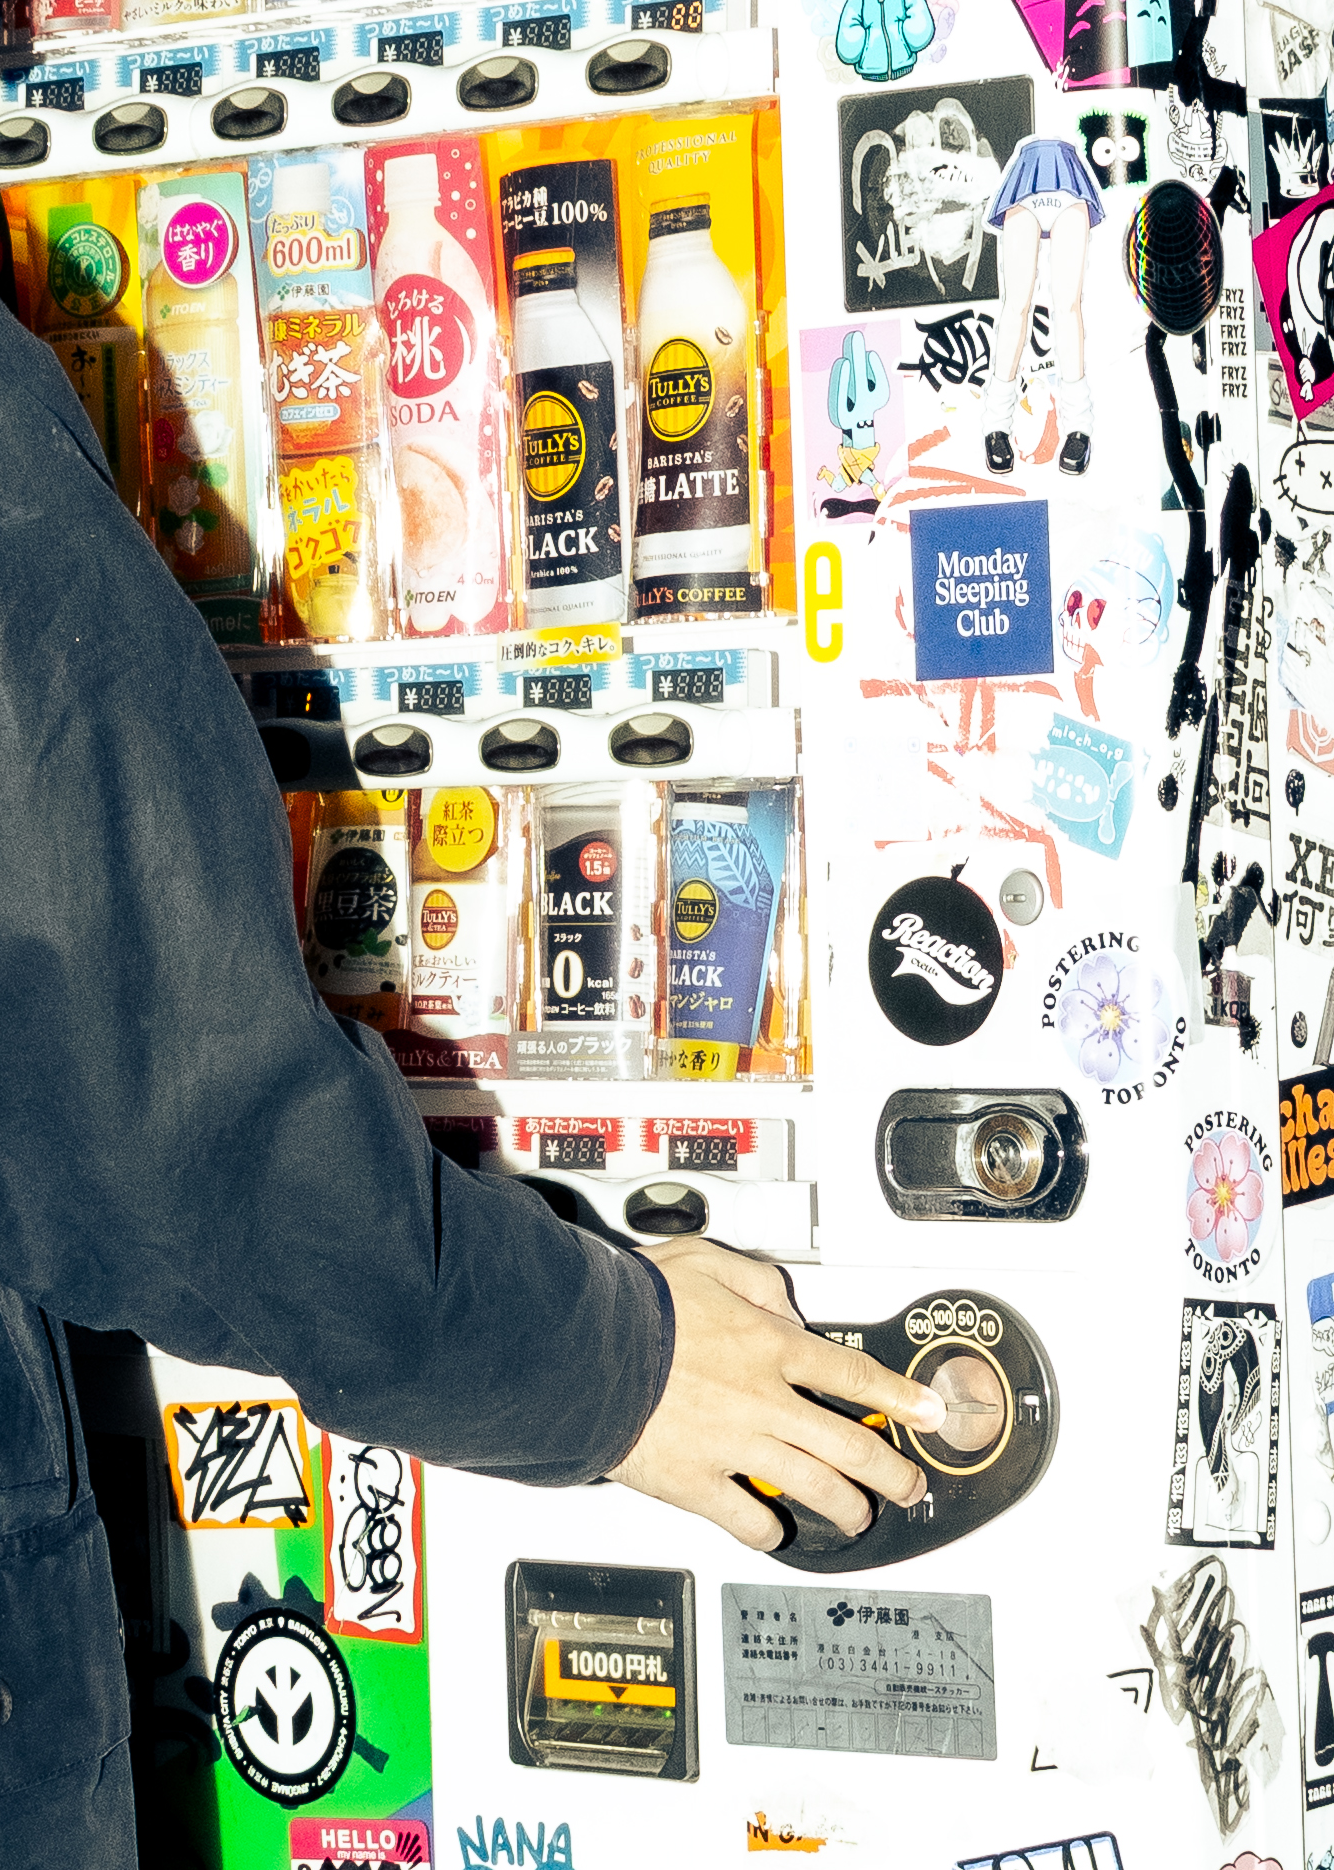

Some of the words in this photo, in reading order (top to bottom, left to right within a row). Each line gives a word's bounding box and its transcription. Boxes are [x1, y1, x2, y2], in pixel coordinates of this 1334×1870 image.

[648, 150, 711, 174] QUALITY
[551, 199, 608, 225] 100%
[1031, 196, 1062, 211] YARD
[168, 218, 223, 244] はなやぐ
[271, 214, 316, 233] たっぷり
[177, 242, 214, 272] 香り
[272, 236, 352, 269] 600ml
[387, 287, 444, 315] とろける
[392, 318, 448, 385] 桃
[270, 341, 362, 402] むぎ茶
[648, 373, 710, 398] TULLY'S
[657, 395, 697, 408] COFFEE
[390, 401, 460, 427] SODA
[523, 432, 579, 456] TULLY'S
[529, 453, 566, 466] COFFEE
[647, 450, 713, 469] BARISTA'S
[556, 565, 579, 577] 100%
[937, 550, 1029, 580] Monday
[414, 591, 435, 604] ITO
[437, 590, 456, 603] EN
[677, 587, 746, 602] COFFEE
[936, 578, 1030, 608] Sleeping
[957, 609, 1010, 636] Club
[442, 800, 474, 821] 紅茶
[432, 824, 484, 847] 際立つ
[542, 892, 613, 916] BLACK
[676, 902, 715, 916] TULLY'S
[422, 909, 457, 924] TULLY'S
[882, 913, 995, 997] Reaction
[553, 949, 584, 999] 0
[587, 976, 614, 989] kcal
[1042, 931, 1142, 1029] POSTERING
[454, 1050, 503, 1070] TEA
[1183, 1110, 1275, 1173] POSTERING
[1183, 1237, 1261, 1283] TORONTO
[909, 1317, 931, 1333] 500
[933, 1308, 953, 1325] 100
[958, 1310, 975, 1326] 50
[980, 1319, 996, 1335] 10
[857, 1606, 909, 1626] 伊藤園
[568, 1648, 667, 1683] 1000円札
[818, 1657, 956, 1677] (03)3441-9911
[322, 1828, 396, 1850] HELLO
[458, 1815, 573, 1869] NANA
[352, 1851, 377, 1859] name
